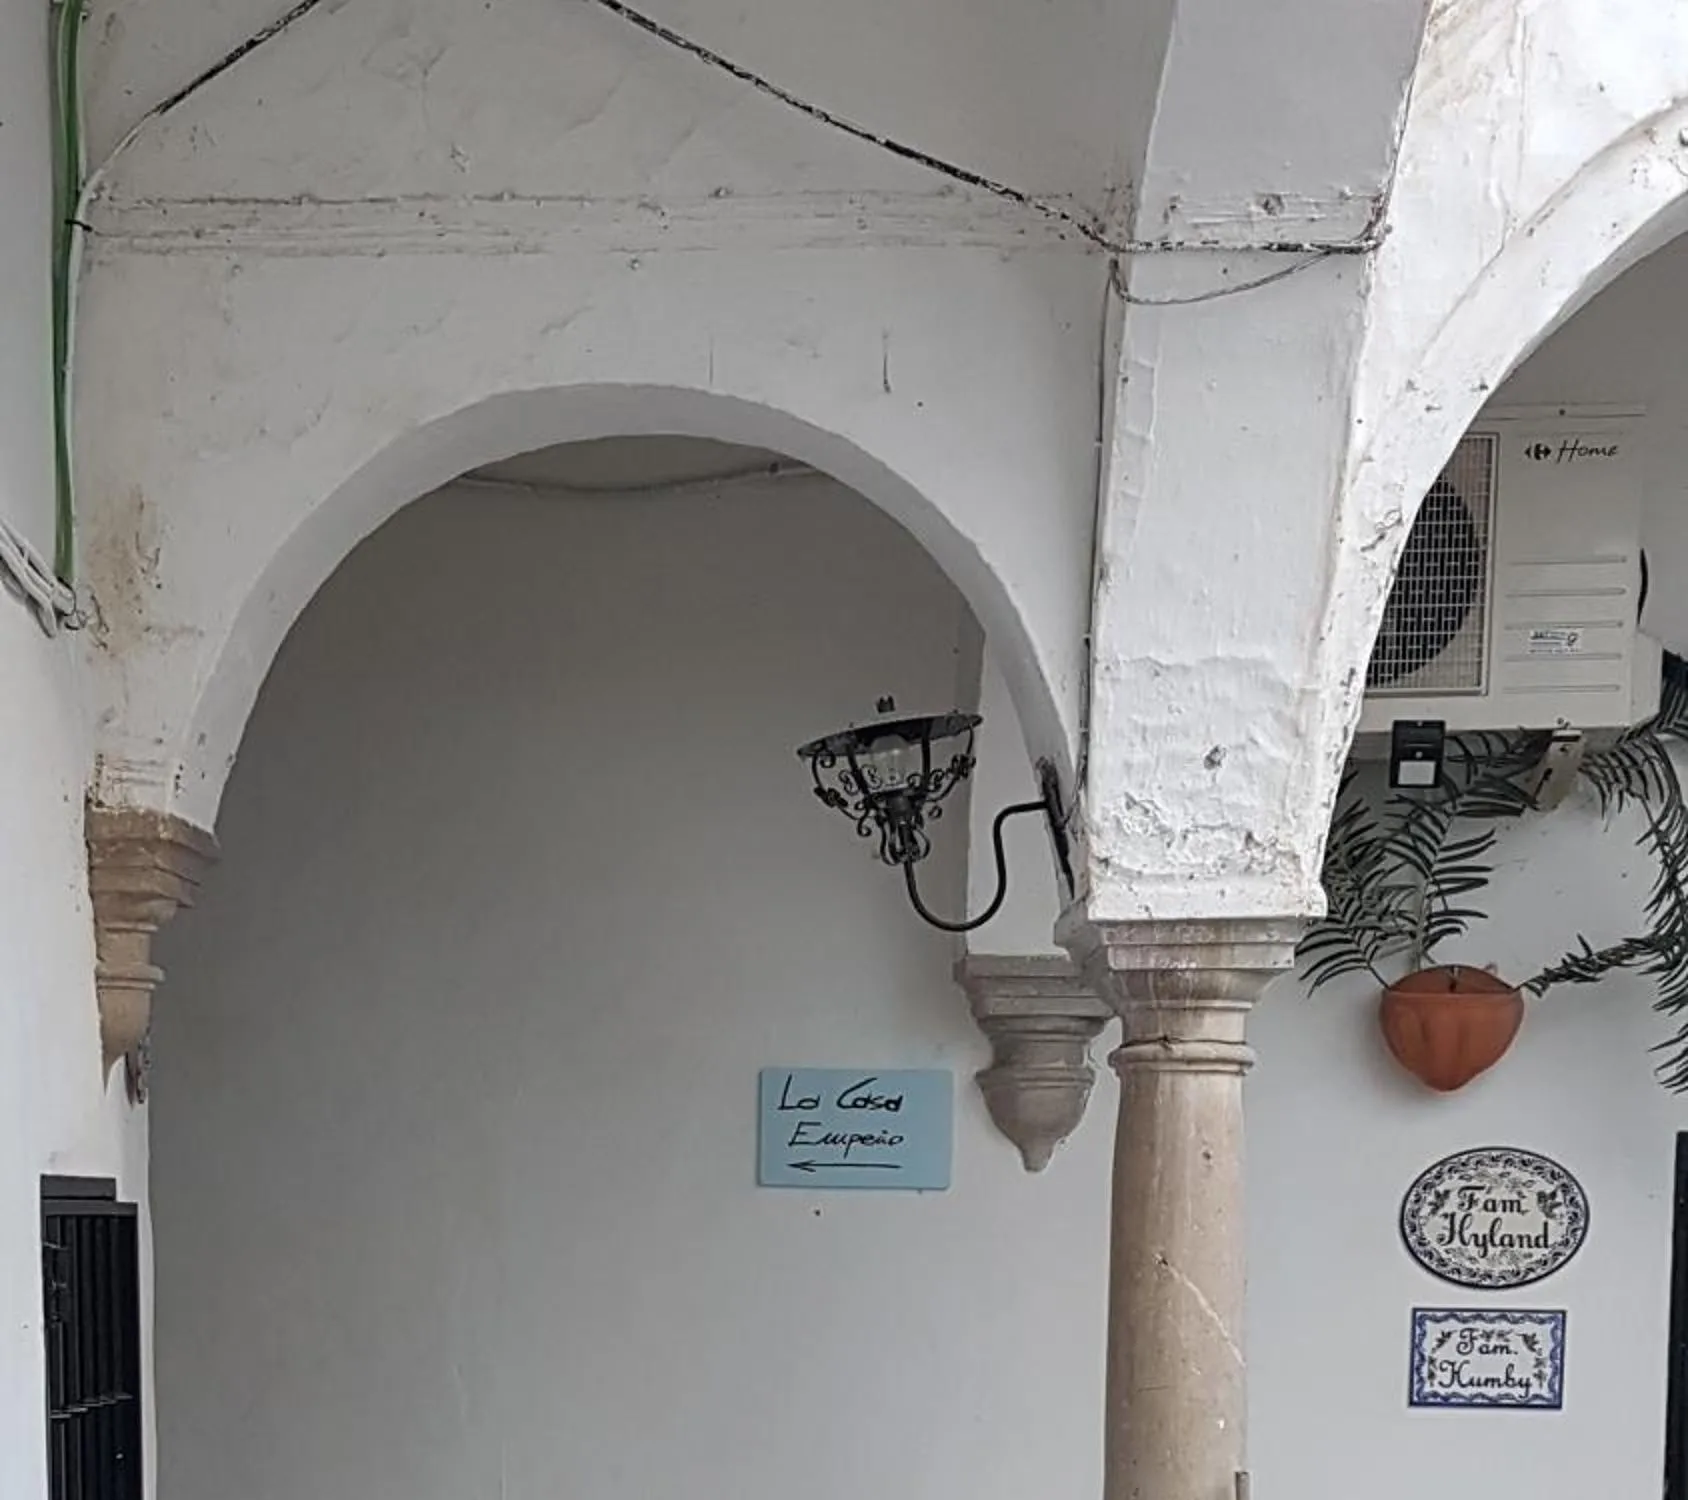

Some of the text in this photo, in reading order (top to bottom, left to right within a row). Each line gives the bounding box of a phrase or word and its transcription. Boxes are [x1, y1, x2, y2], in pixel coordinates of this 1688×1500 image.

[1556, 438, 1618, 463] Home
[777, 1074, 904, 1112] La Casa
[1436, 1211, 1549, 1259] Hyland
